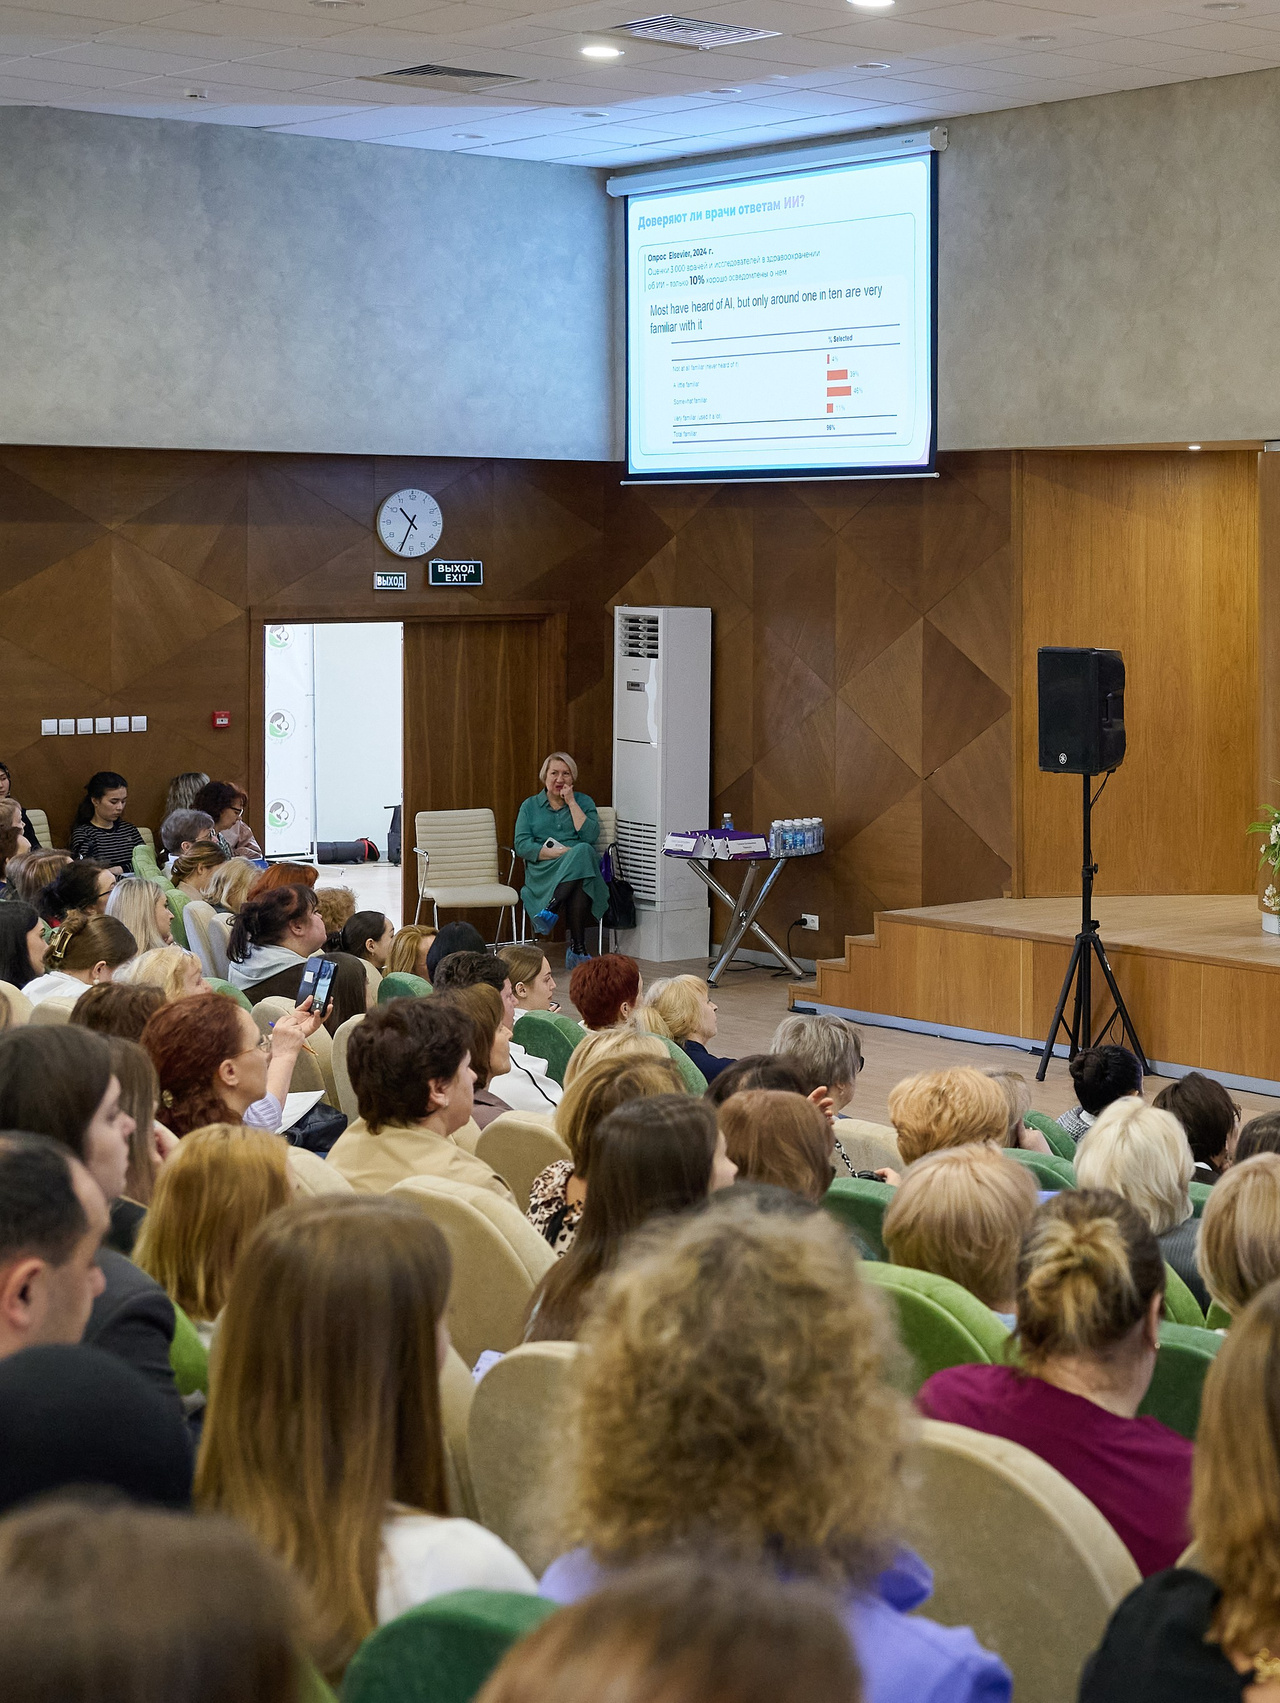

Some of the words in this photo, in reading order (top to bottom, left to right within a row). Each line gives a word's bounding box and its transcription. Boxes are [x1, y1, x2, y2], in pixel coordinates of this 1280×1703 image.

[638, 212, 687, 230] Доверяют
[690, 210, 702, 222] ли
[706, 205, 736, 221] врачи
[739, 201, 780, 215] ответам
[784, 195, 804, 209] ИИ?
[648, 253, 666, 263] Опрос
[669, 250, 692, 260] Elsevier,
[687, 262, 707, 272] врачей
[714, 256, 760, 268] исследователей
[767, 250, 820, 263] здравоохранении
[648, 281, 655, 290] об
[690, 274, 705, 285] 10%
[706, 276, 727, 284] хорошо
[650, 304, 668, 316] Most
[670, 303, 689, 315] have
[691, 300, 713, 312] heard
[716, 298, 724, 310] of
[724, 297, 735, 310] AI,
[738, 296, 750, 308] but
[752, 294, 768, 308] only
[771, 291, 799, 304] around
[802, 291, 817, 302] one
[820, 289, 826, 300] in
[828, 288, 842, 299] ten
[846, 287, 861, 298] are
[864, 285, 882, 298] very
[650, 322, 677, 334] familiar
[679, 320, 695, 331] with
[698, 319, 702, 330] it
[833, 334, 853, 342] Selected
[438, 565, 475, 573] ВЫХОД
[377, 576, 403, 587] ВЫХОД
